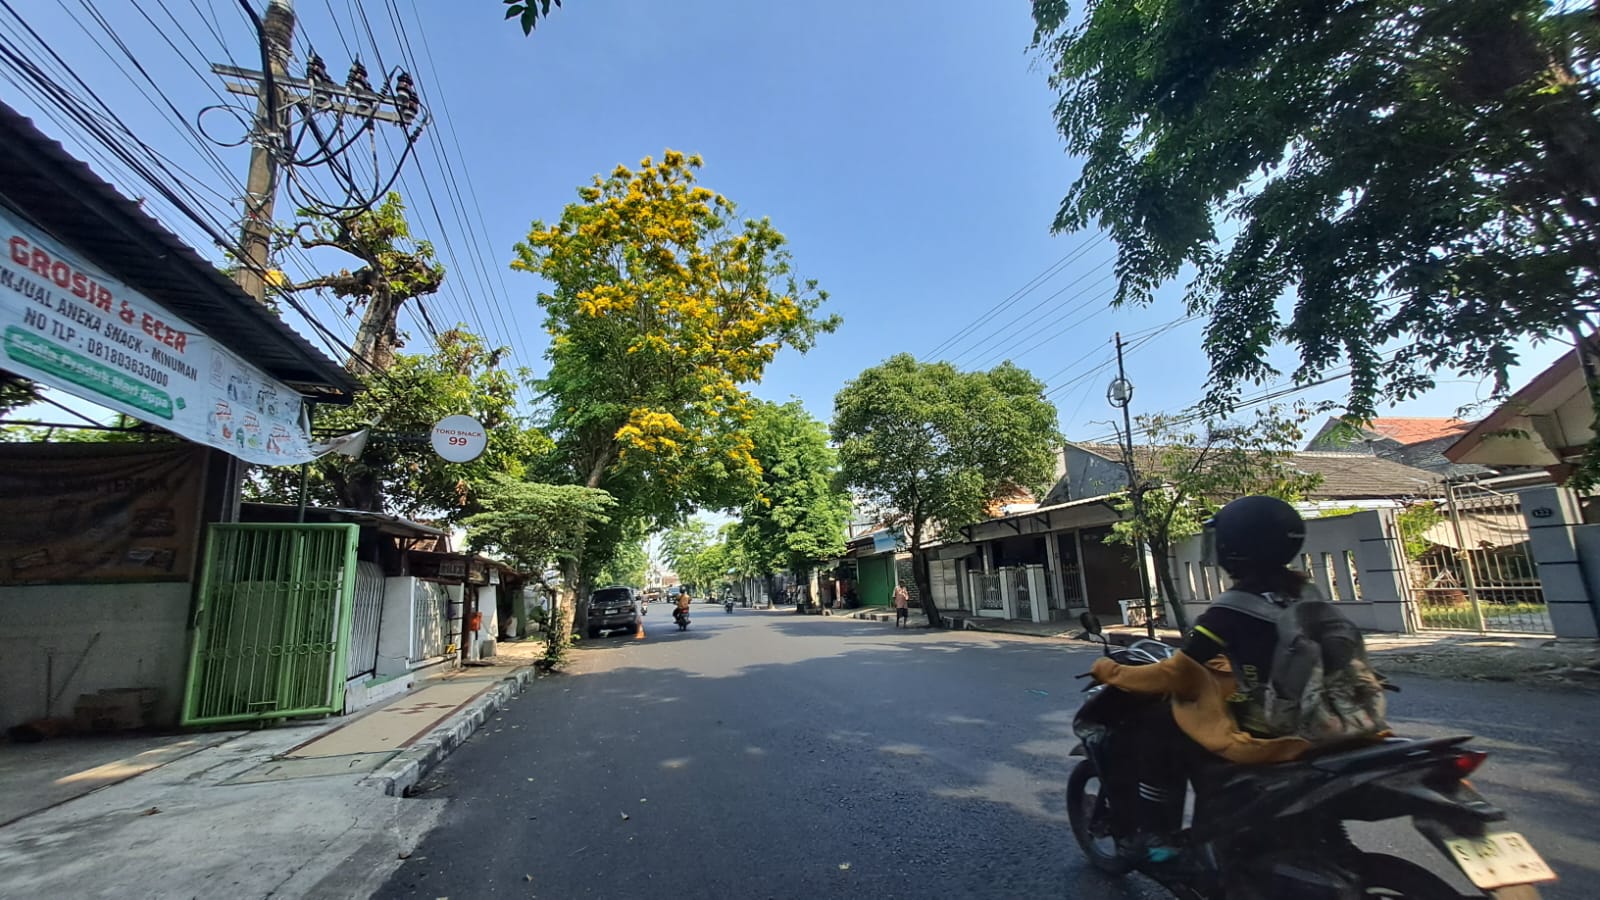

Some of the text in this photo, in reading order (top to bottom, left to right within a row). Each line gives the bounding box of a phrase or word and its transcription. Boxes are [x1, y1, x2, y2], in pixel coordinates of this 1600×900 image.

[0, 265, 53, 309] NJUAL
[56, 298, 102, 333] ANEKA
[104, 323, 143, 354] SNACK
[151, 347, 198, 382] MINUMAN
[9, 236, 187, 354] GROSIR & ECER
[24, 307, 47, 331] NO
[52, 320, 76, 343] TLP
[448, 436, 468, 447] 99
